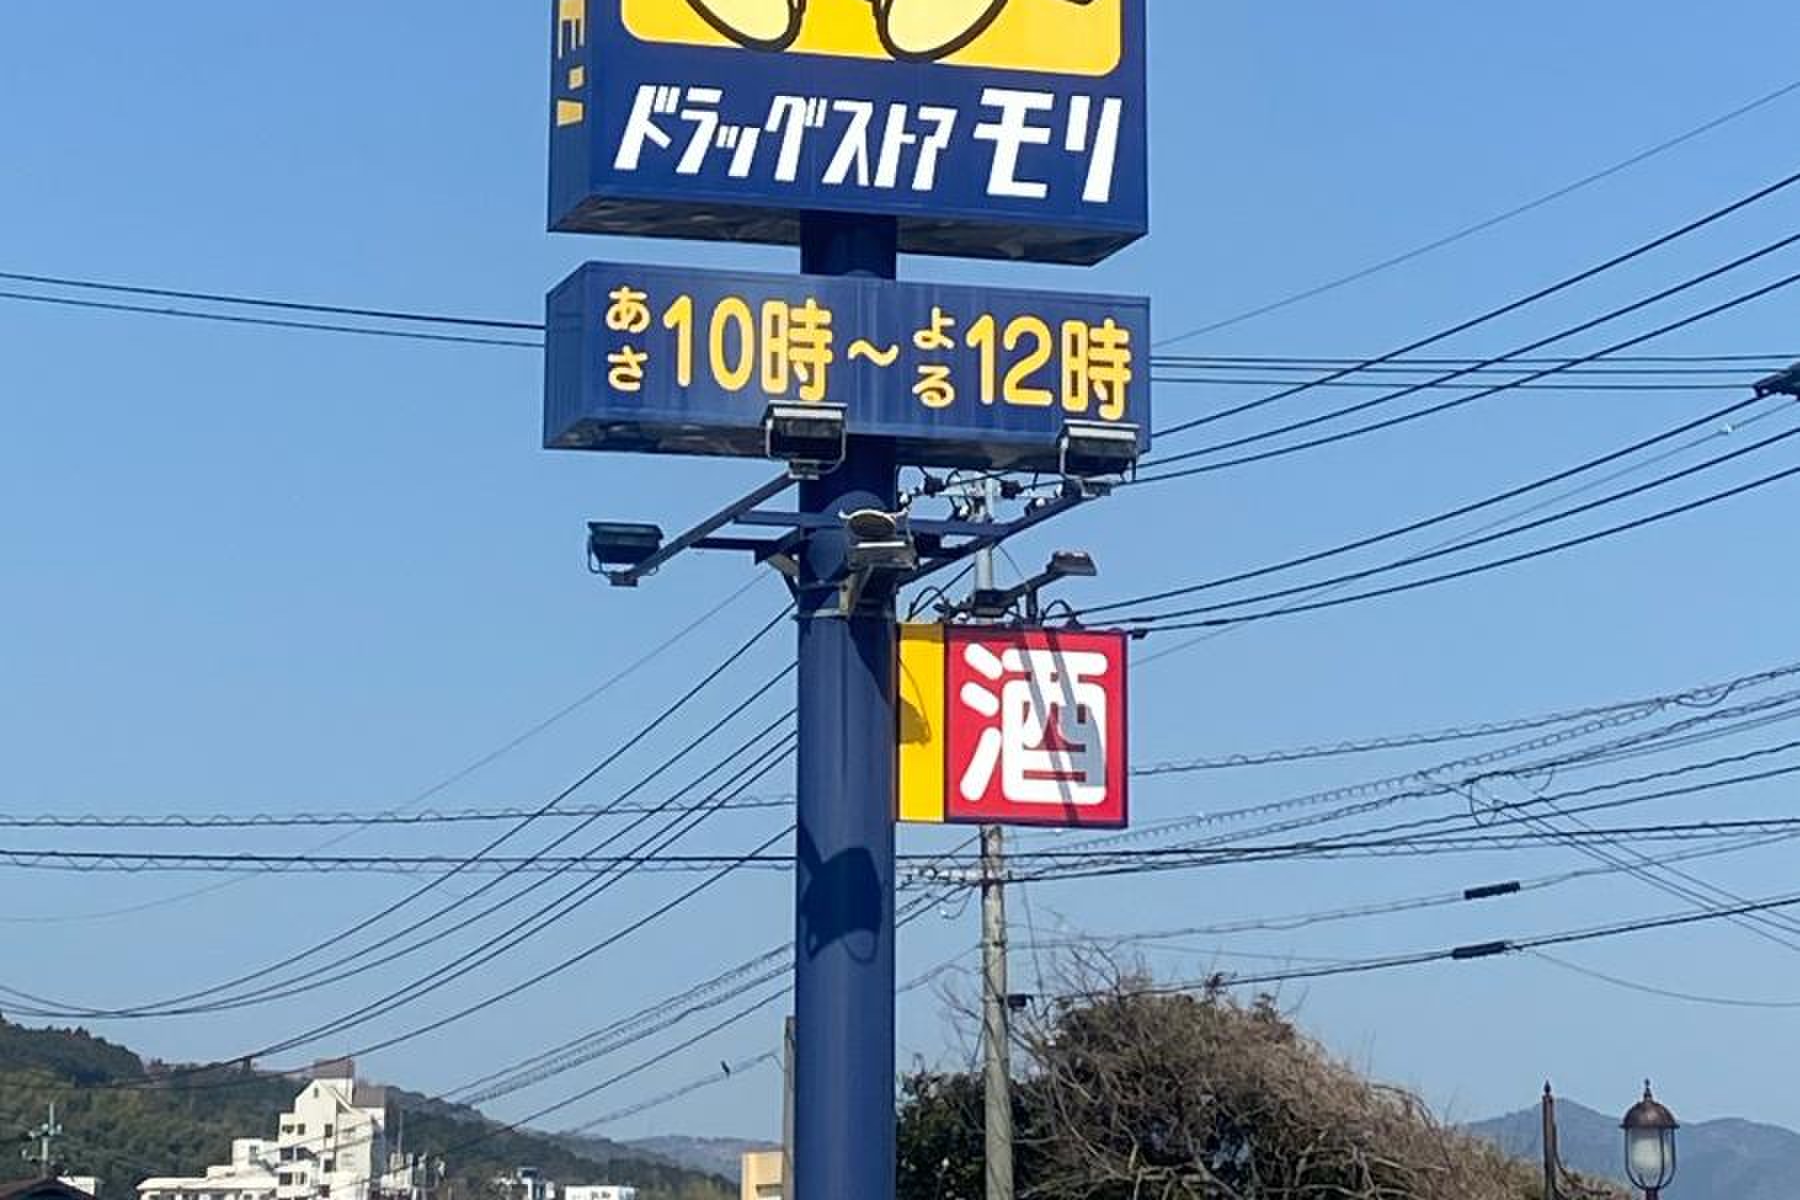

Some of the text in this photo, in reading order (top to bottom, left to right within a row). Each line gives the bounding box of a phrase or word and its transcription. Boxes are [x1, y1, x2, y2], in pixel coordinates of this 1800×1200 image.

[612, 84, 1123, 203] ドラッグストア モリ
[605, 285, 651, 393] あさ
[911, 306, 956, 409] よる
[960, 642, 1107, 805] 酒
